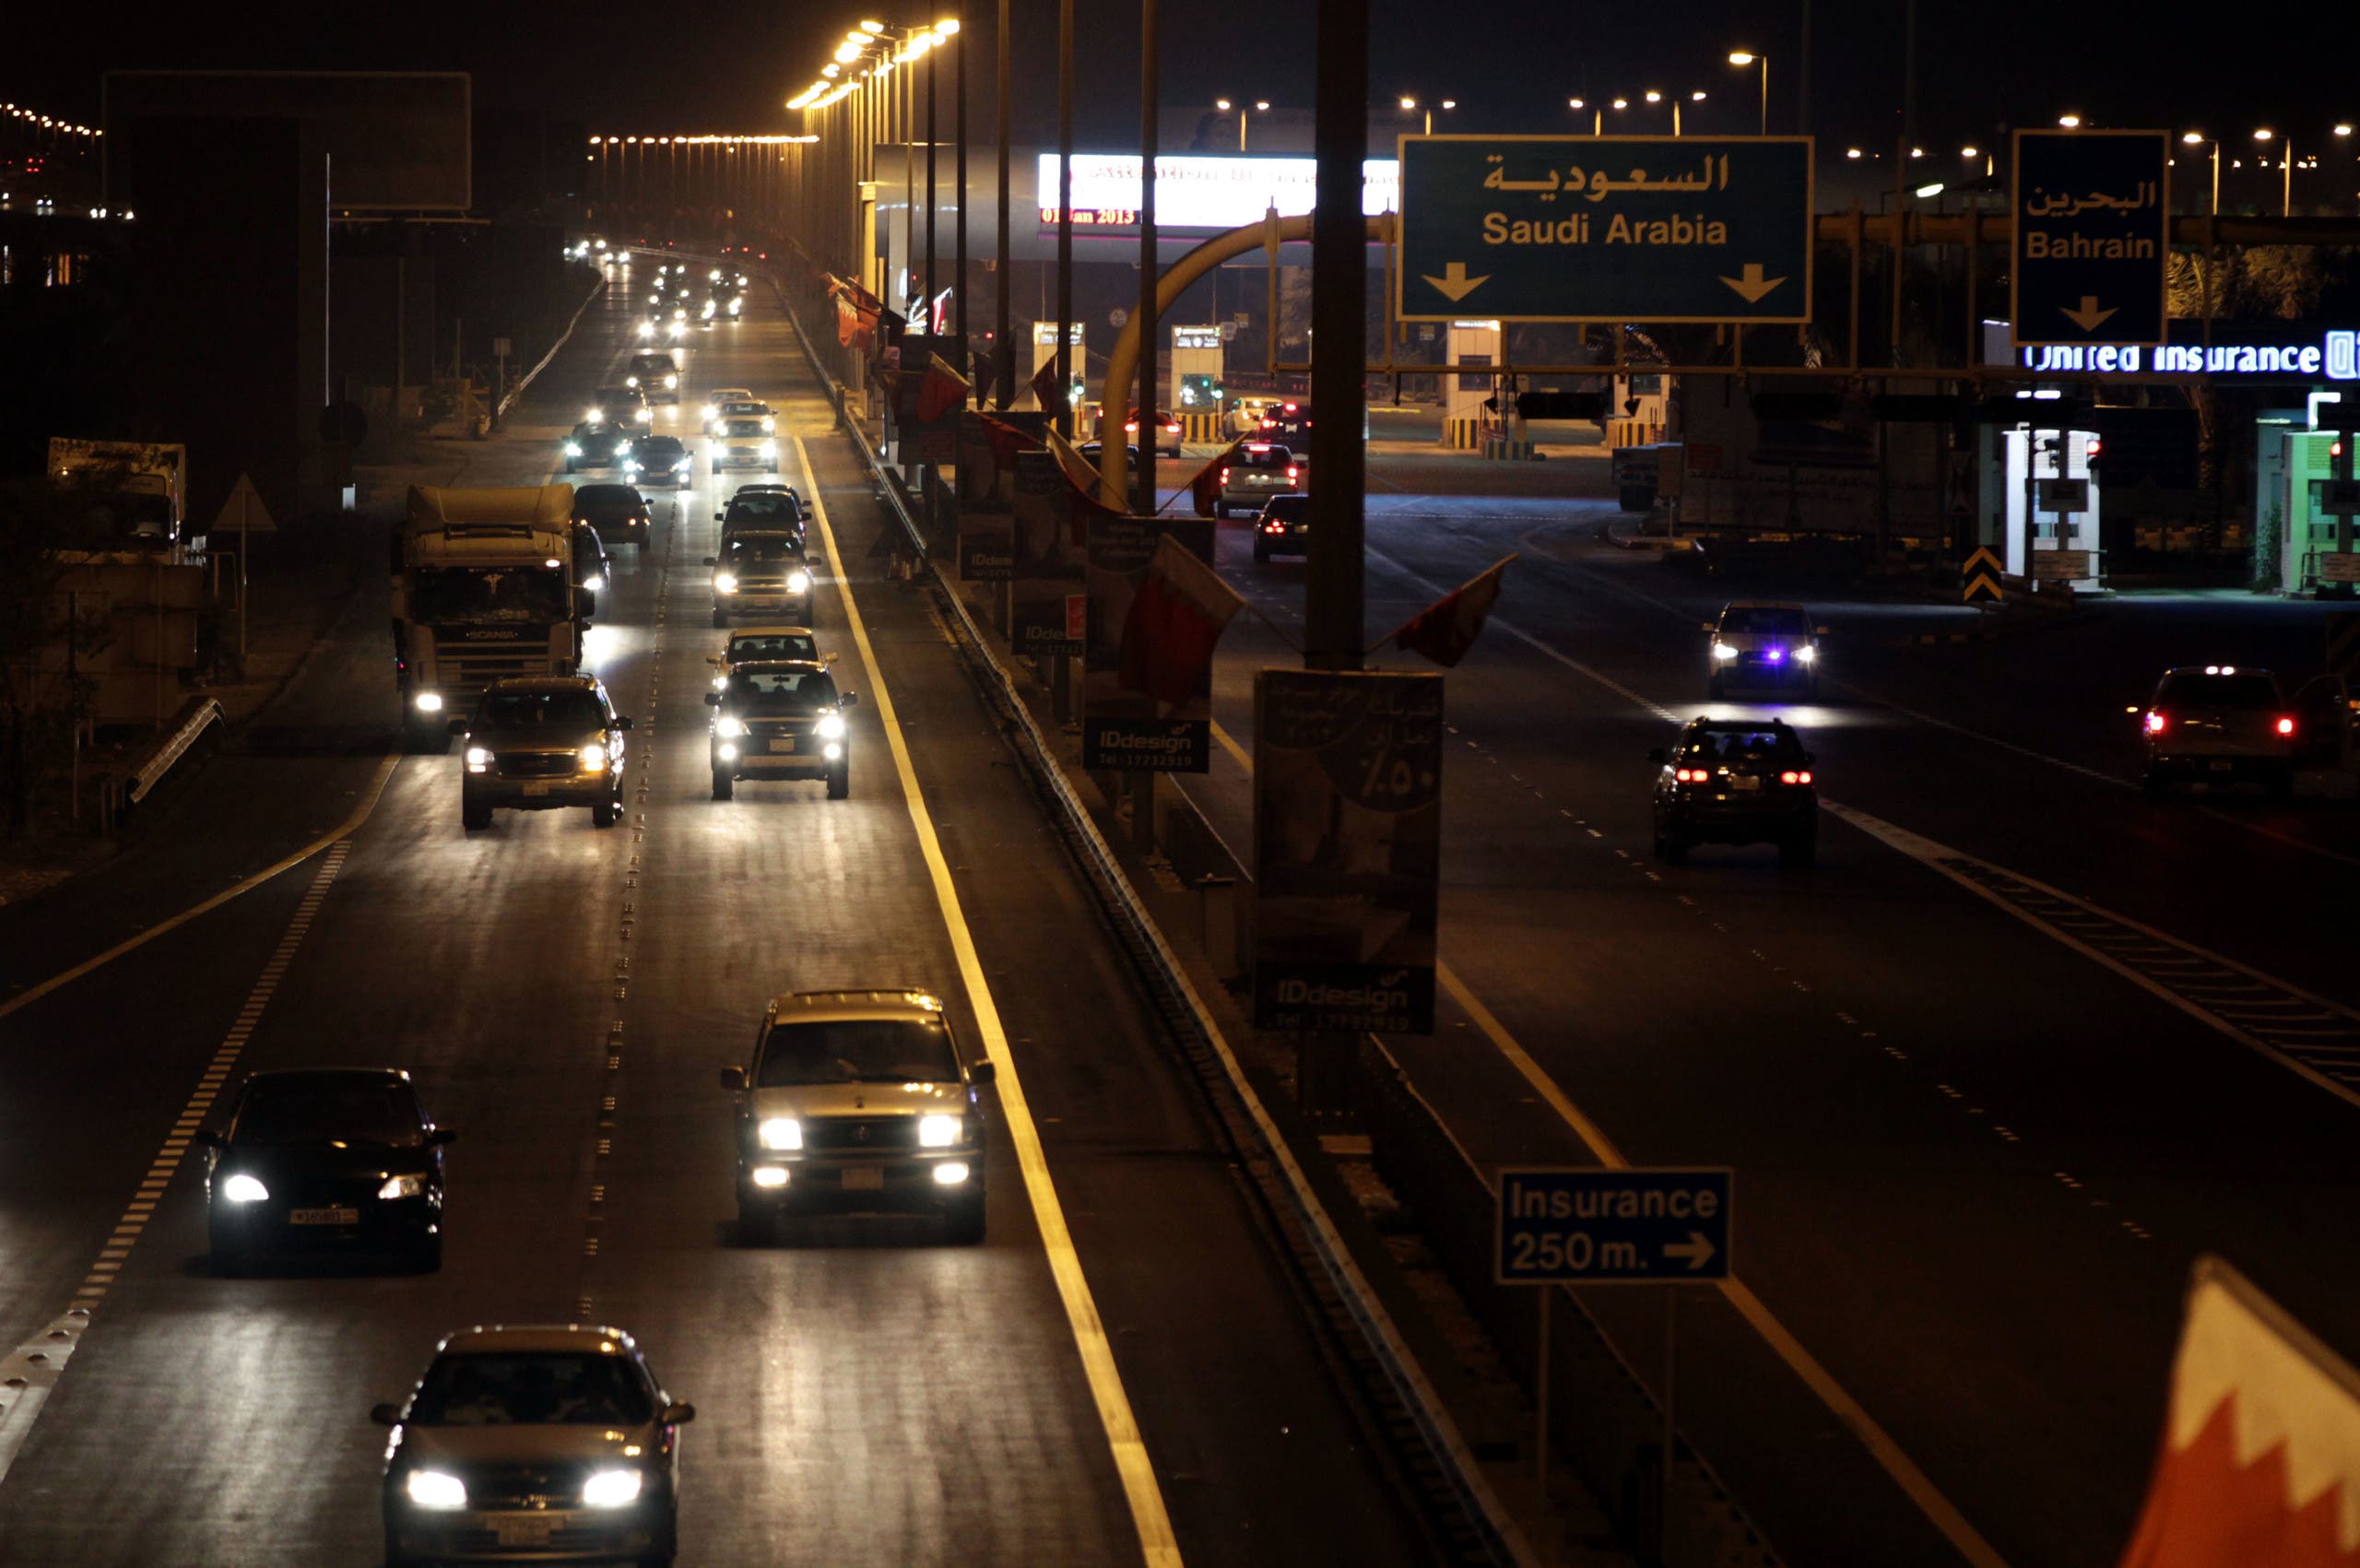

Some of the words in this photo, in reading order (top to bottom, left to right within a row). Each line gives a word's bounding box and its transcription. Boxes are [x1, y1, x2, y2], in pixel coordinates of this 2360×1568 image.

[1482, 150, 1729, 202] السعودية
[2027, 178, 2157, 218] البحرين
[1097, 209, 1136, 224] 2013
[1482, 212, 1589, 245] Saudi
[1606, 212, 1728, 245] Arabia
[2027, 230, 2154, 260] Bahrain
[1098, 731, 1192, 753] IDdesign
[1277, 978, 1409, 1013] IDdesign
[1509, 1180, 1718, 1220] Insurance
[1509, 1230, 1593, 1271] 250
[1599, 1240, 1648, 1270] m.
